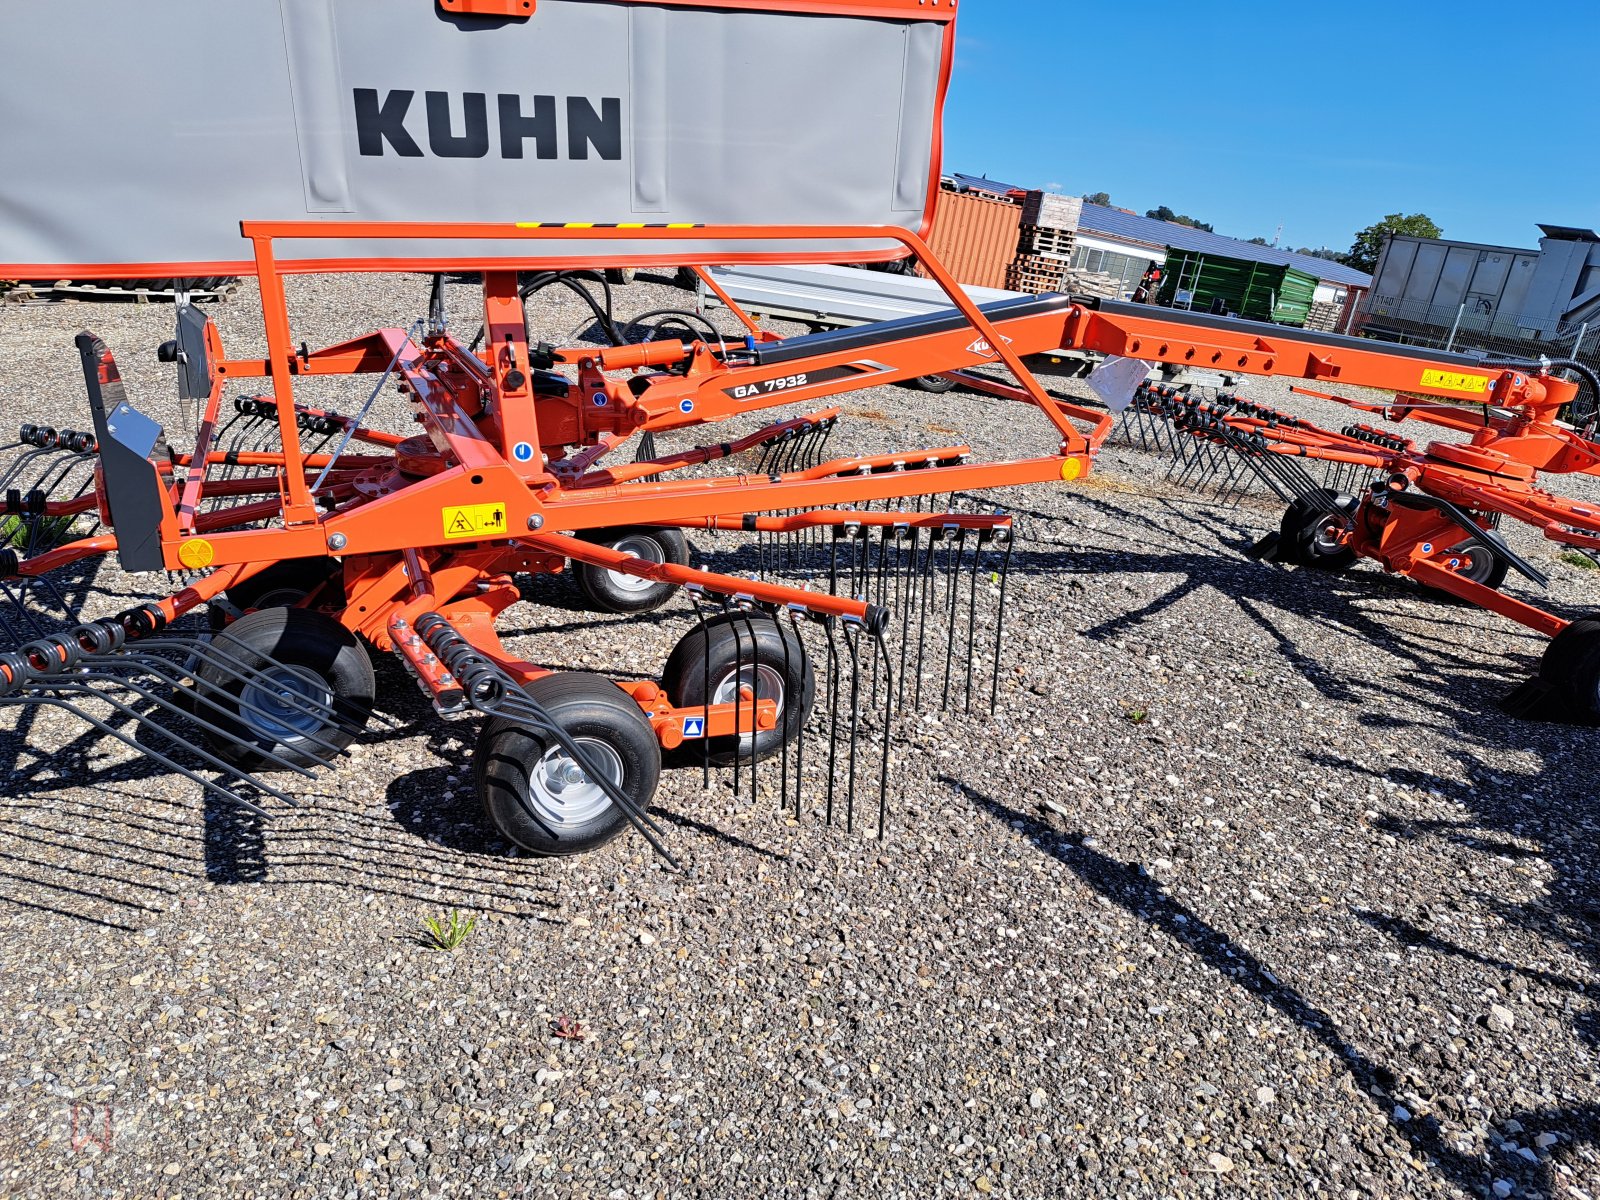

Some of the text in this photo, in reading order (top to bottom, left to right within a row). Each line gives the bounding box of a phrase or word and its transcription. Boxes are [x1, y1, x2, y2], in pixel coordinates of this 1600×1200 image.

[353, 88, 621, 160] KUHN
[734, 373, 807, 398] GA 7932
